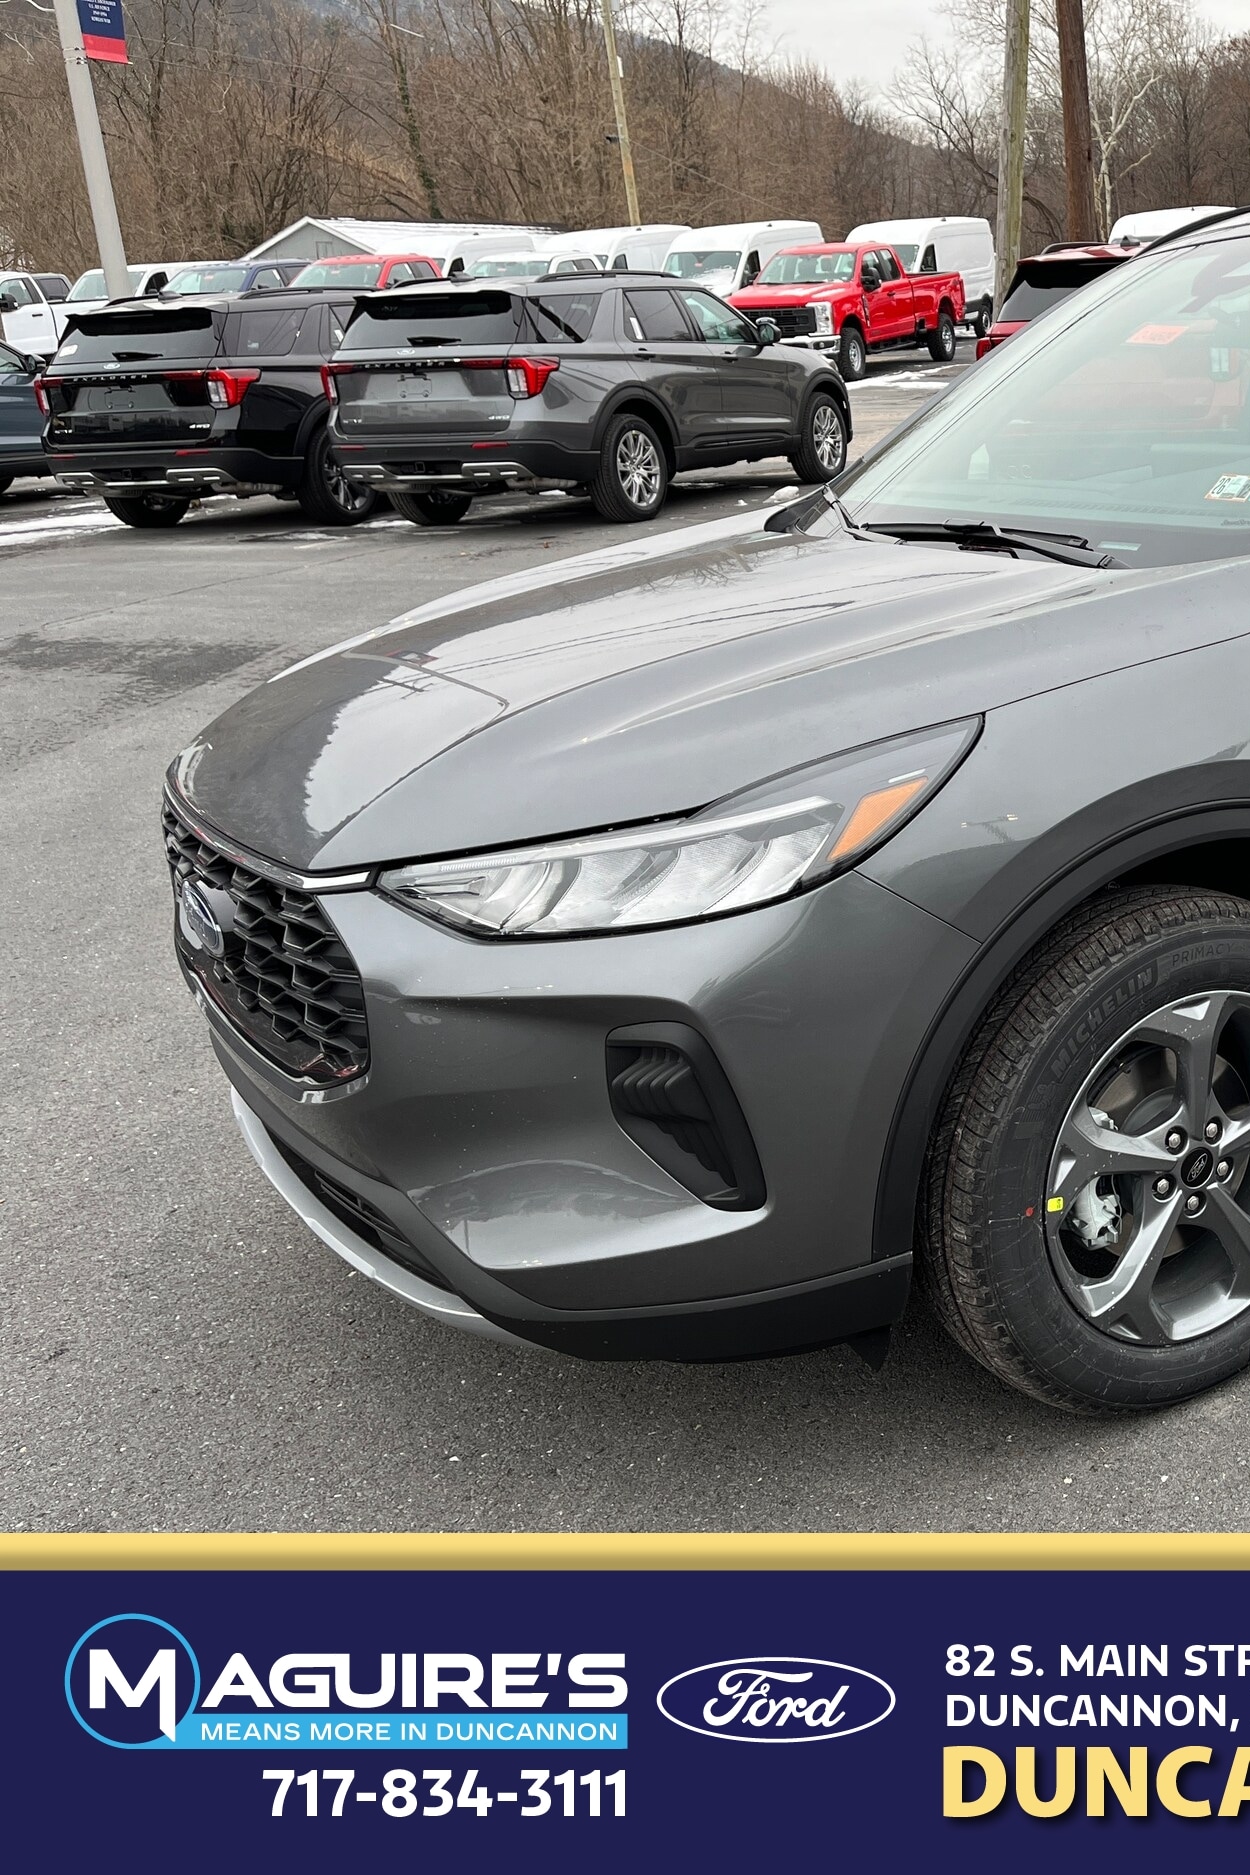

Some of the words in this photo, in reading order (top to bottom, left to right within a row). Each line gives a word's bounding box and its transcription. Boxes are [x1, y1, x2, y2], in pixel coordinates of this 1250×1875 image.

[1211, 477, 1231, 495] 26
[1050, 967, 1153, 1079] MICHELIN
[1172, 943, 1232, 966] PRIMACY
